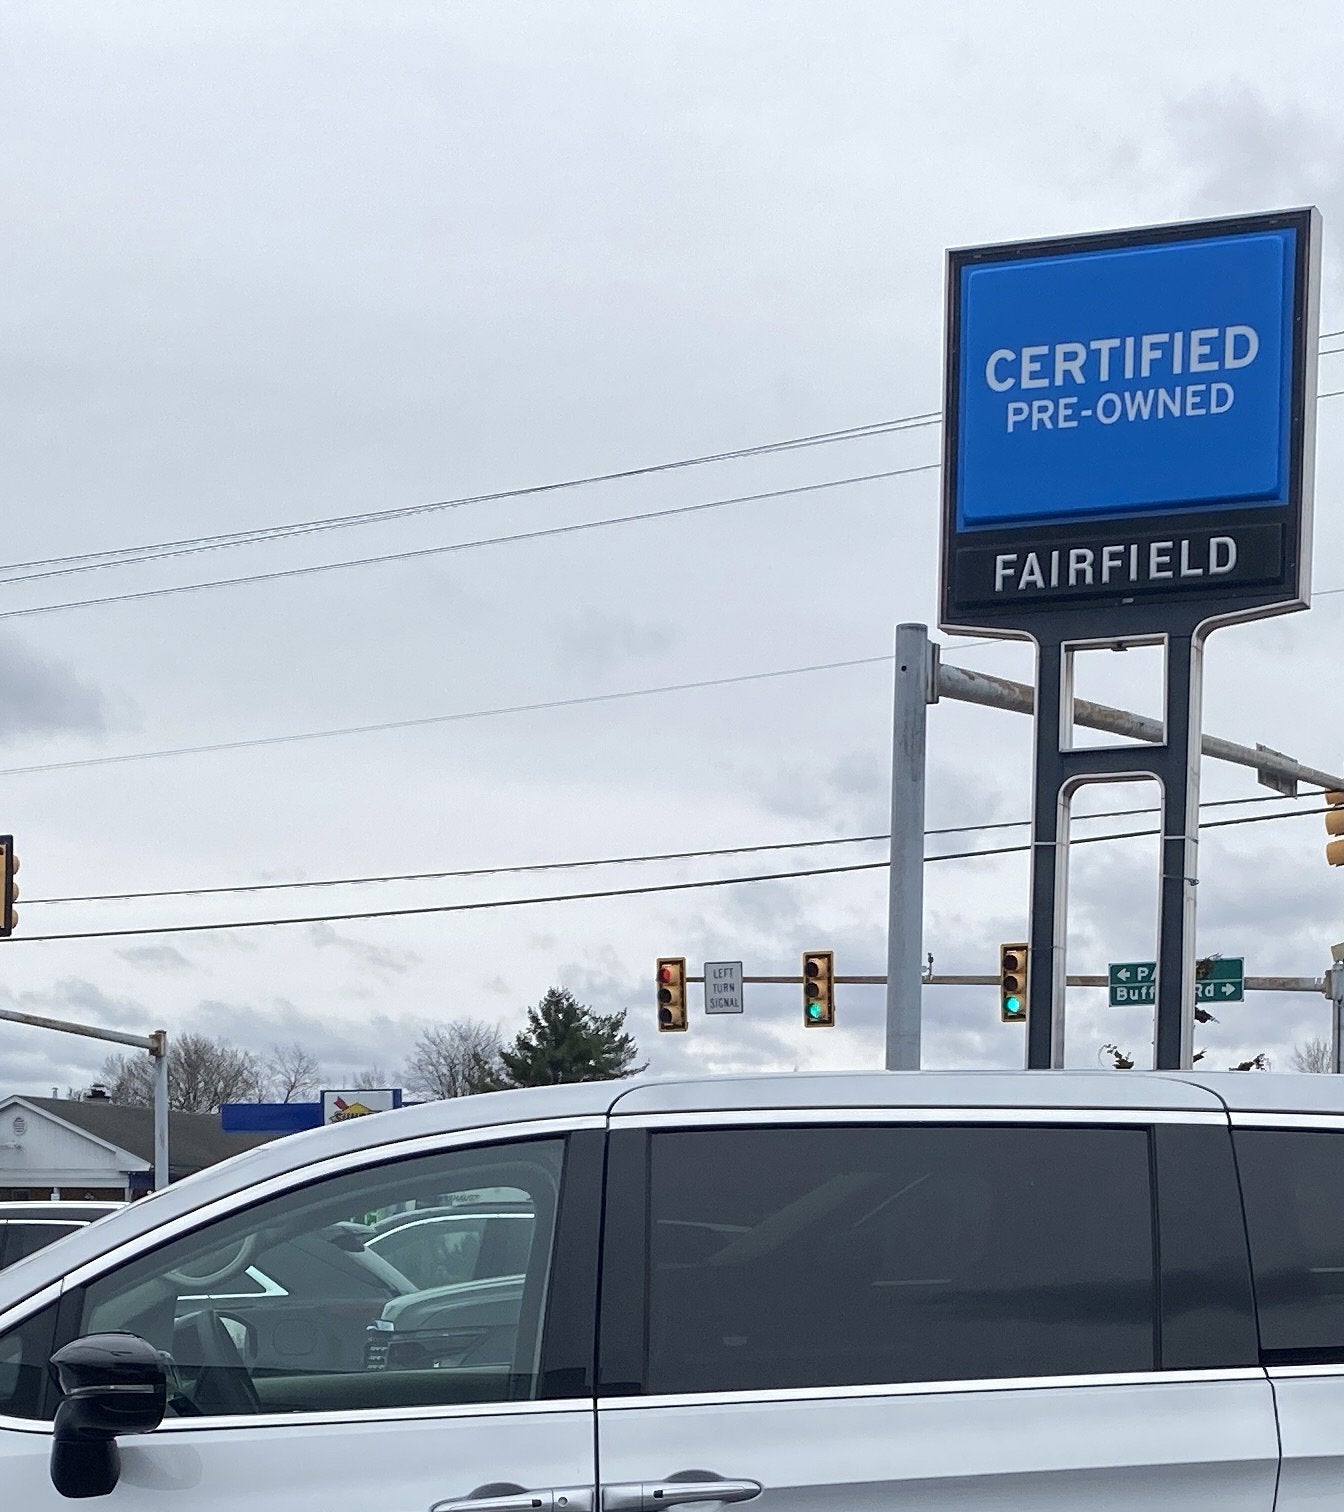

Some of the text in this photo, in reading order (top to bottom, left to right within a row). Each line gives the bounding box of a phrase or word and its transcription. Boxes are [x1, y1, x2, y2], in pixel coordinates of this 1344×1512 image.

[985, 325, 1259, 393] CERTIFIED
[1006, 382, 1235, 433] PRE-OWNED
[994, 535, 1238, 592] FAIRFIELD
[713, 967, 734, 979] LEFT
[713, 982, 735, 994] TURN
[1116, 985, 1155, 1001] Buff
[709, 997, 740, 1009] SIGNAL
